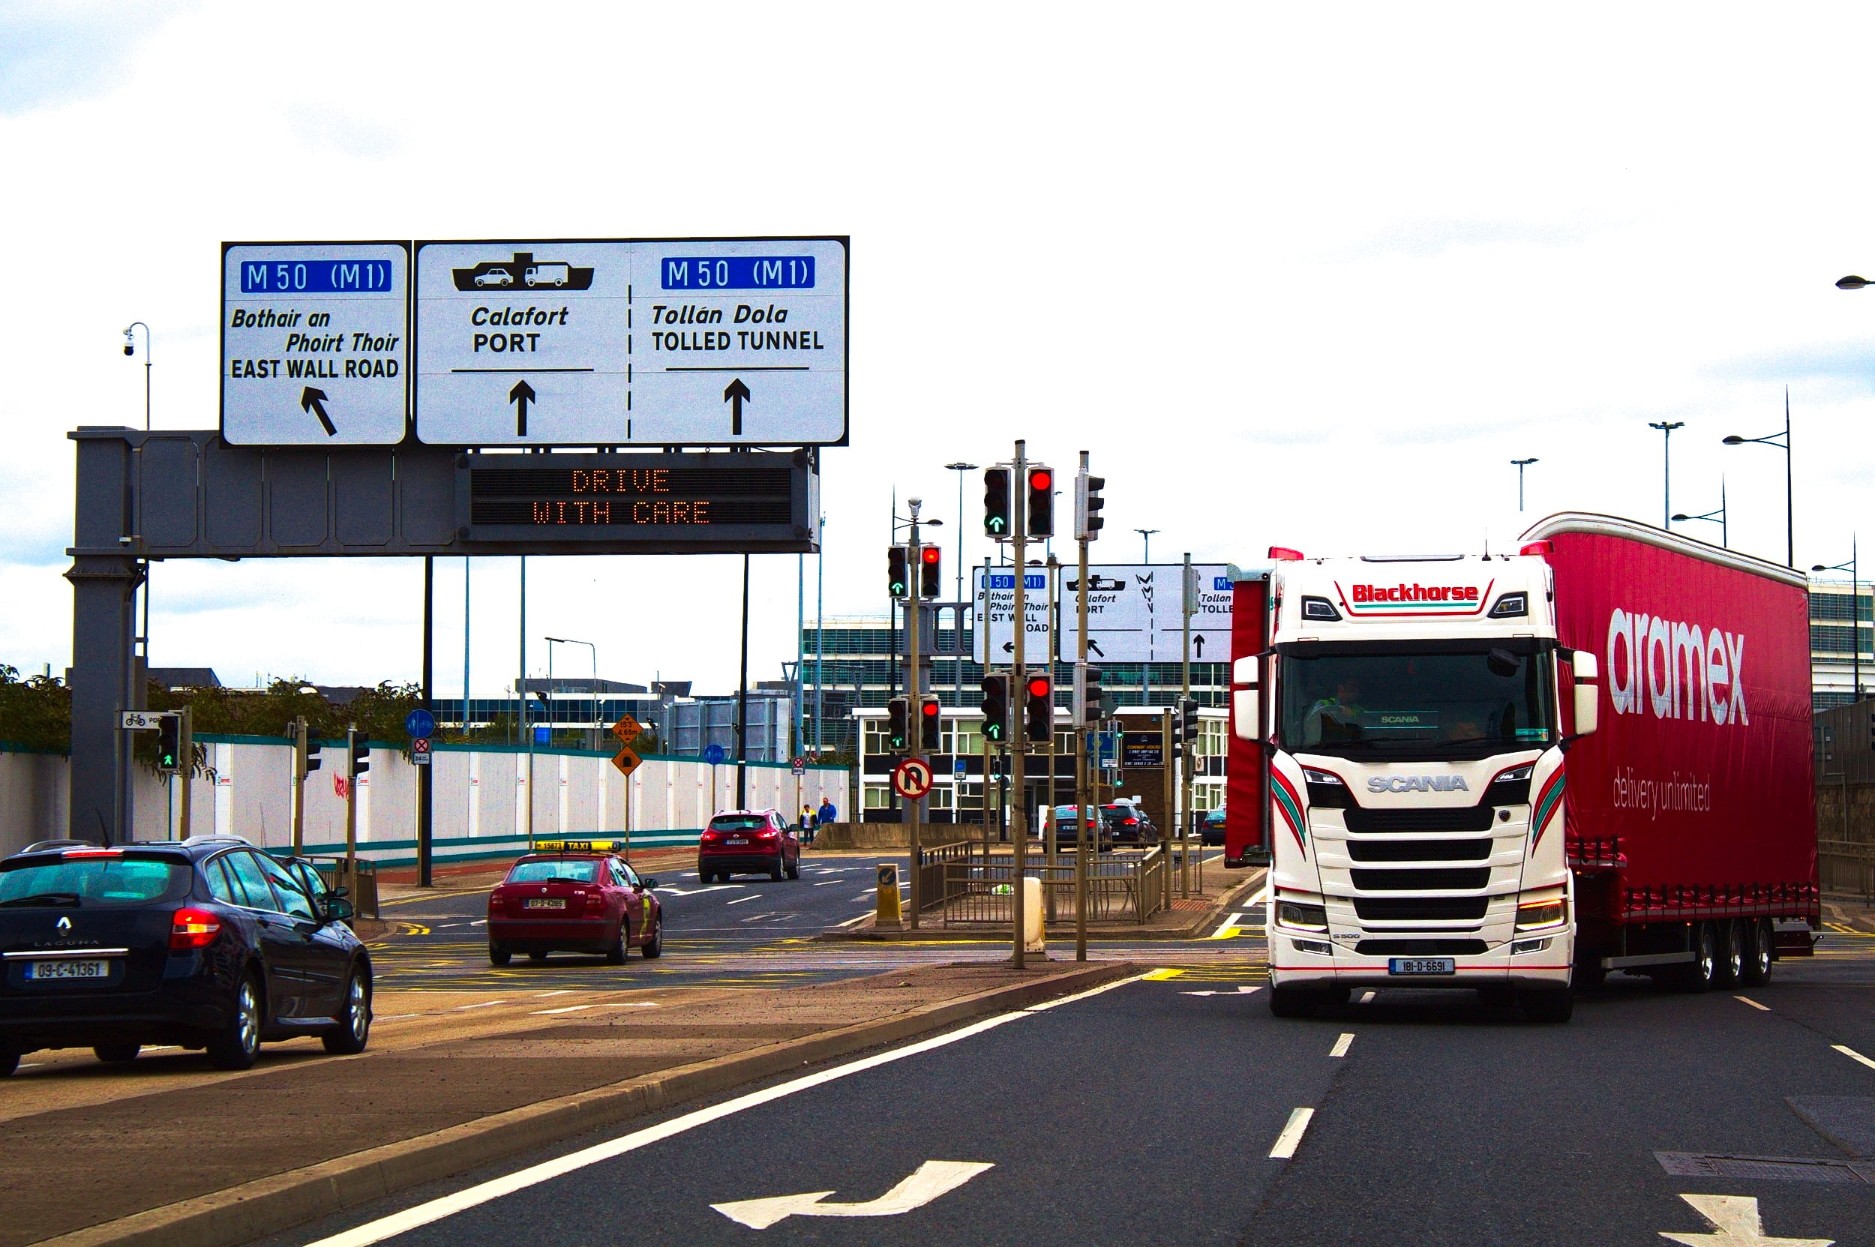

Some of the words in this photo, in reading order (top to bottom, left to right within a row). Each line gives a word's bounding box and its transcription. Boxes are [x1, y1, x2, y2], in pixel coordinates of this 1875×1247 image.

[331, 263, 384, 290] (M1)
[753, 259, 808, 286] (M1)
[231, 308, 302, 328] Bothair
[308, 312, 331, 328] an
[471, 306, 569, 327] Calafort
[652, 304, 722, 325] Tollán
[733, 303, 788, 324] Dola
[285, 333, 344, 352] Phoirt
[351, 333, 399, 352] Thoir
[473, 333, 541, 352] PORT
[652, 331, 731, 351] TOLLED
[737, 330, 824, 350] TUNNEL
[231, 359, 281, 379] EAST
[287, 359, 339, 379] WALL
[344, 359, 399, 379] ROAD
[573, 469, 670, 492] DRIVE
[533, 501, 610, 524] WITH
[633, 501, 710, 524] CARE
[1024, 576, 1042, 588] M1)
[977, 592, 1014, 601] Bthair
[1075, 594, 1116, 603] lafort
[1353, 583, 1479, 603] Blackhorse
[990, 603, 1016, 611] Phoir
[1201, 604, 1234, 614] TOLLE
[977, 613, 1005, 622] EST
[1008, 613, 1037, 622] WLL
[1026, 623, 1049, 633] OAD
[1607, 607, 1749, 726] aramex
[1381, 715, 1420, 723] SCANIA
[1366, 775, 1470, 793] SCANIA
[1613, 766, 1659, 821] delivery
[1661, 771, 1711, 812] unlimited
[567, 842, 589, 850] TAXI
[38, 962, 100, 978] 09-C-41361
[1403, 961, 1445, 972] 181-D-6691
